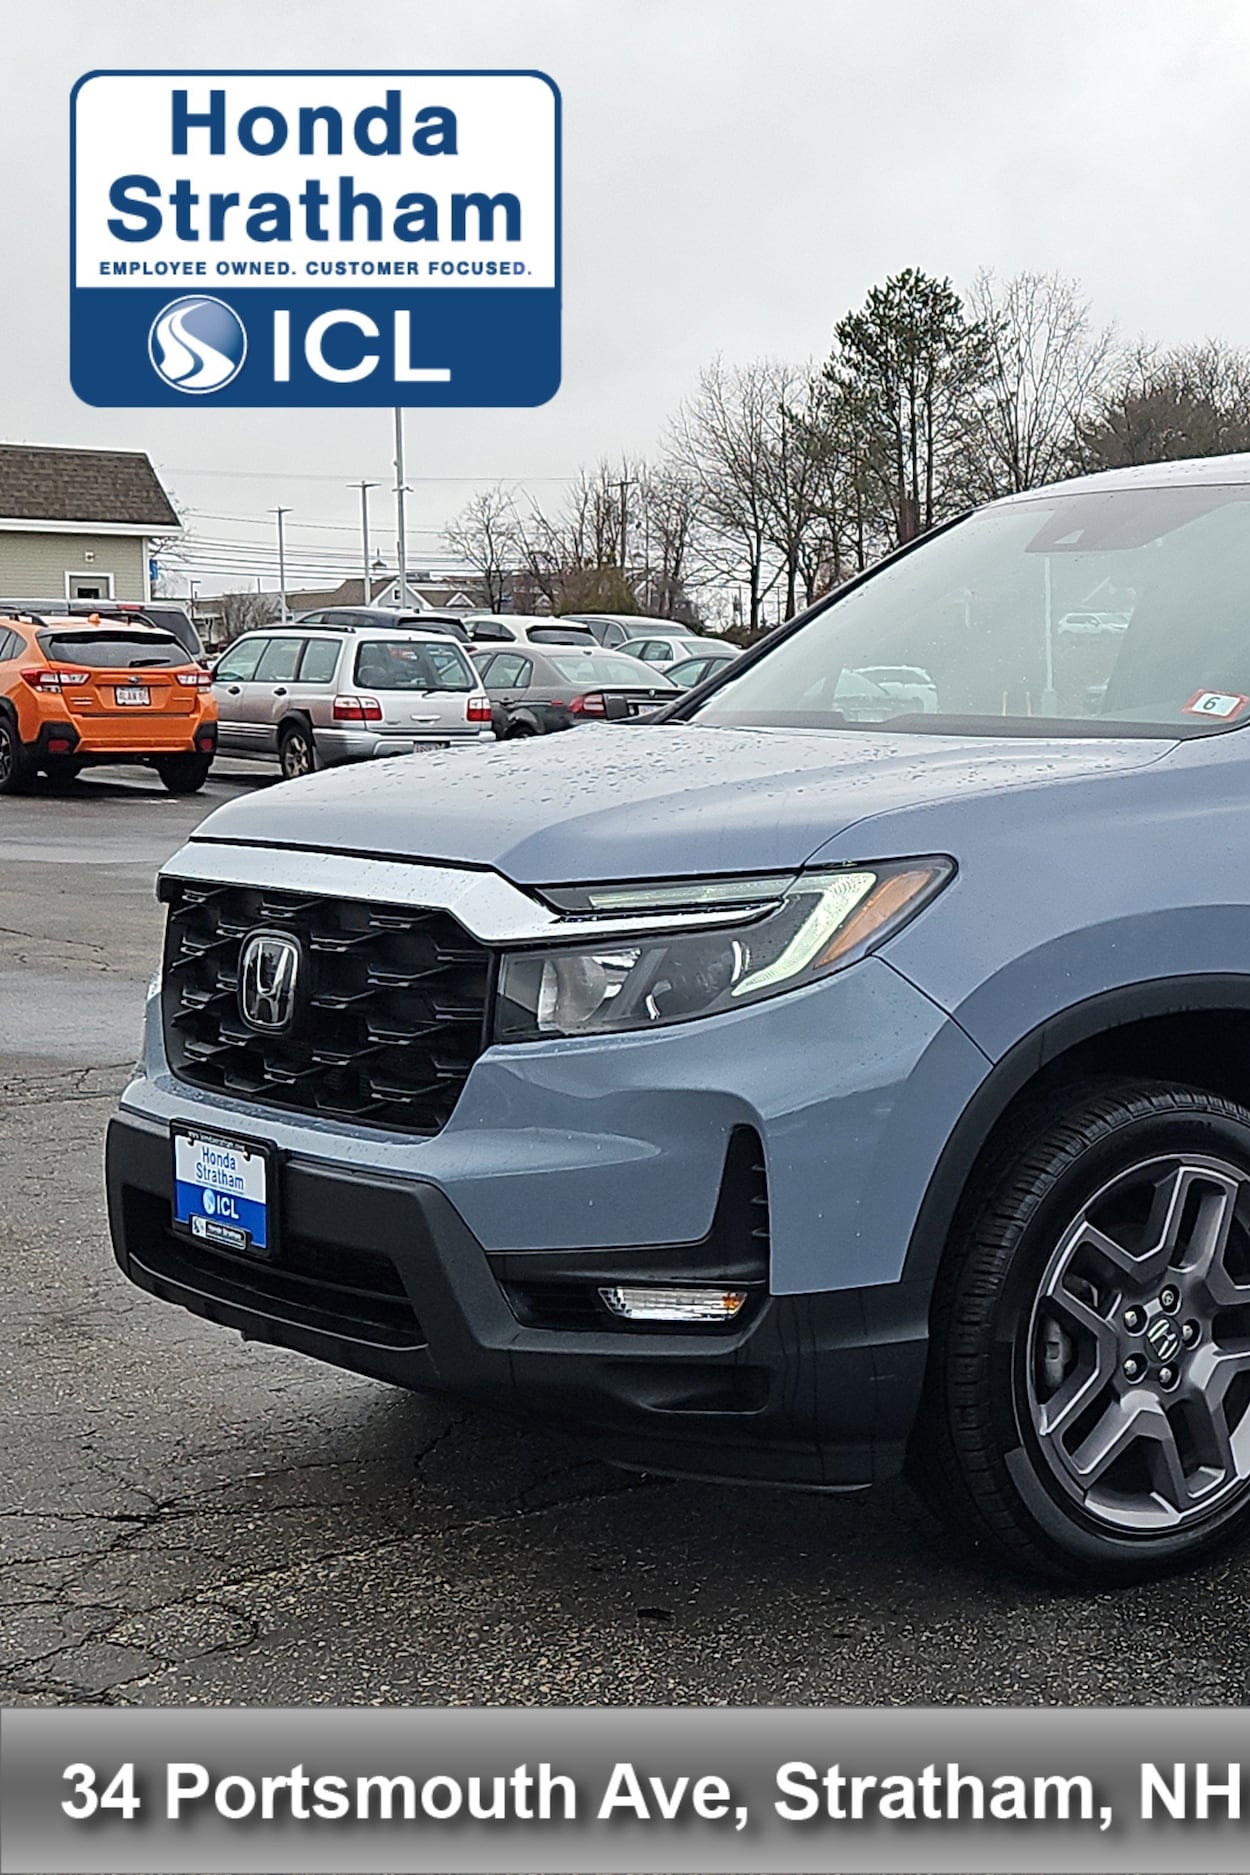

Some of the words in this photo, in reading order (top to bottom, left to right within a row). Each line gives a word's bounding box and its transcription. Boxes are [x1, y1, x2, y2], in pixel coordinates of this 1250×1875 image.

[1203, 697, 1220, 710] 6
[202, 1146, 236, 1170] Honda
[196, 1162, 244, 1190] Stratham
[216, 1195, 239, 1219] ICL
